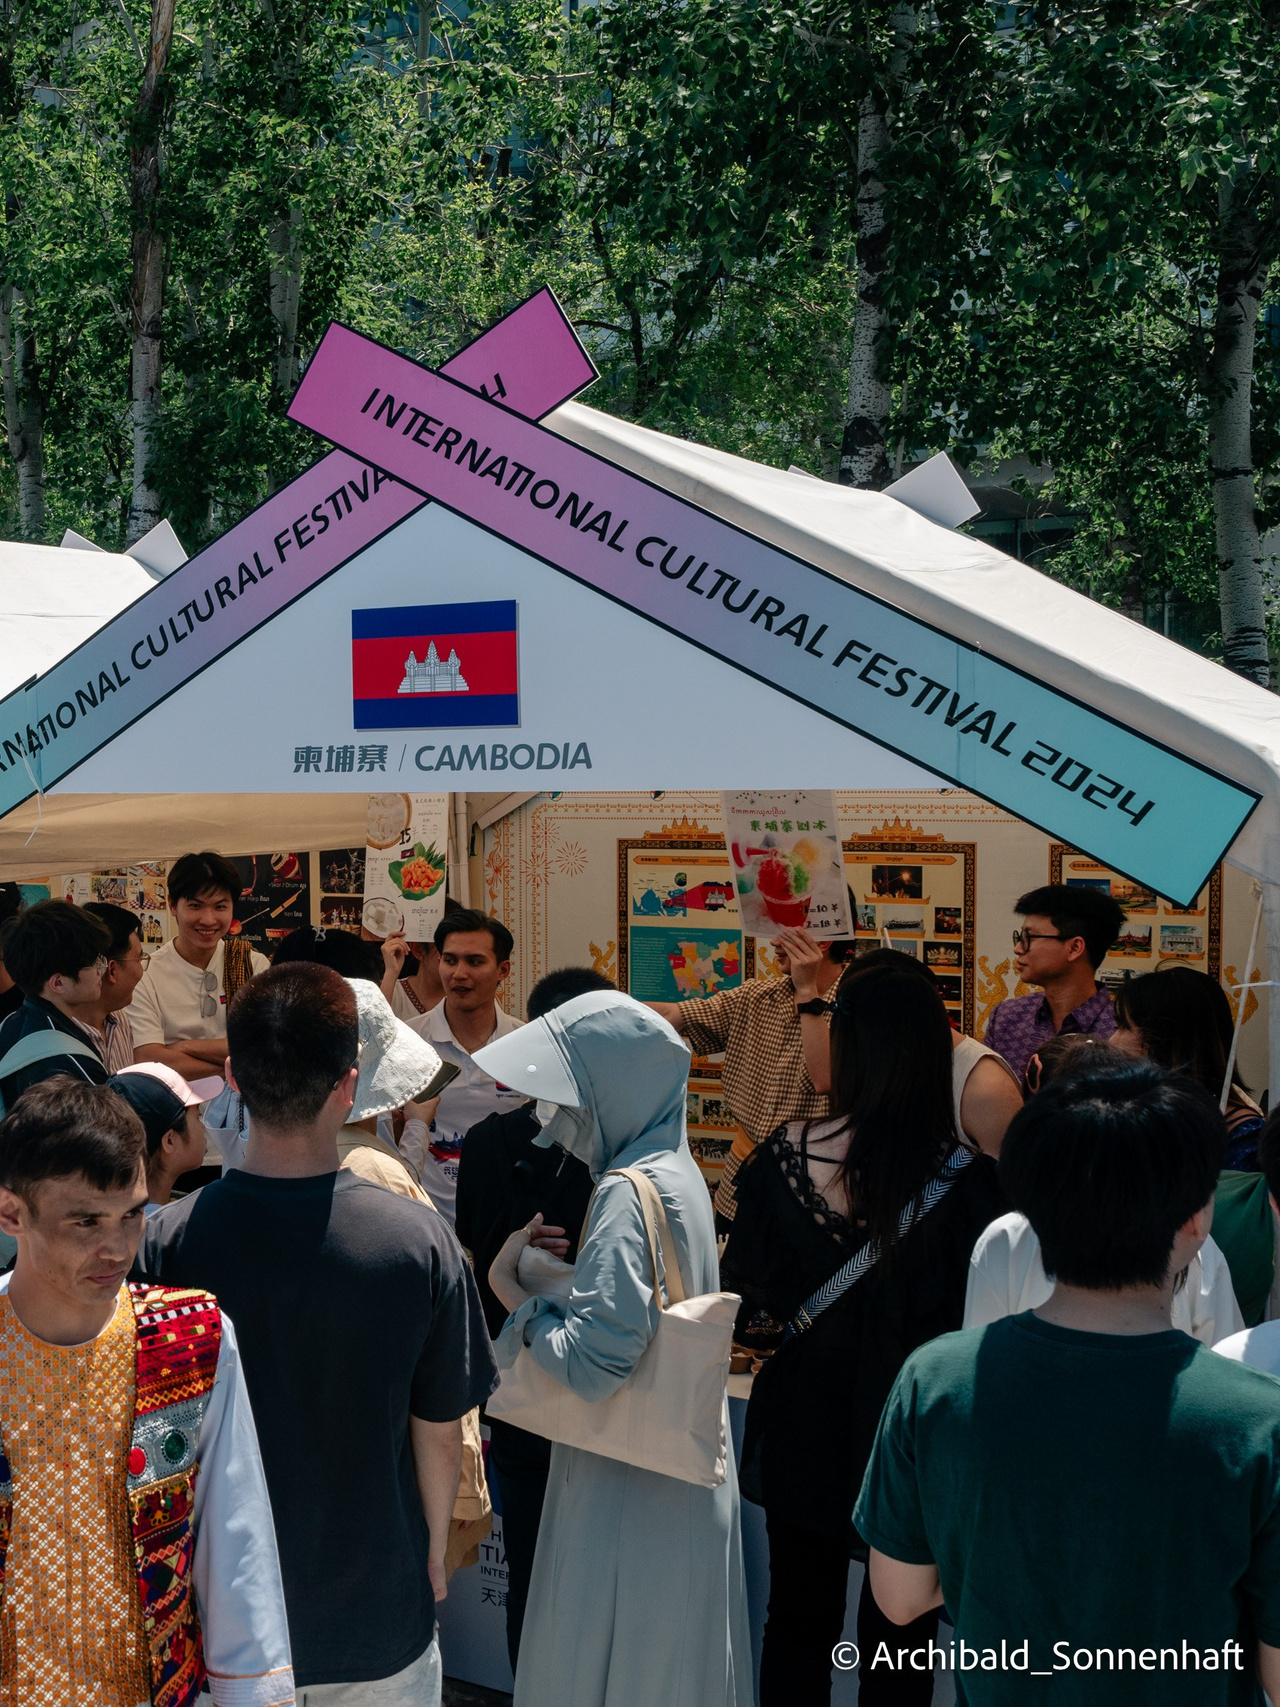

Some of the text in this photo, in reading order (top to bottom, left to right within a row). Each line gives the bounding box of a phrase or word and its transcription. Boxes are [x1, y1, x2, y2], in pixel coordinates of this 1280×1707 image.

[130, 551, 274, 670] CULTURAL
[273, 467, 393, 564] FESTIVA
[361, 388, 1155, 826] INTERNATIONAL CULTURAL FESTIVAL 2024
[293, 742, 592, 773] 柬埔寨 CAMBODIA
[399, 828, 411, 845] 15
